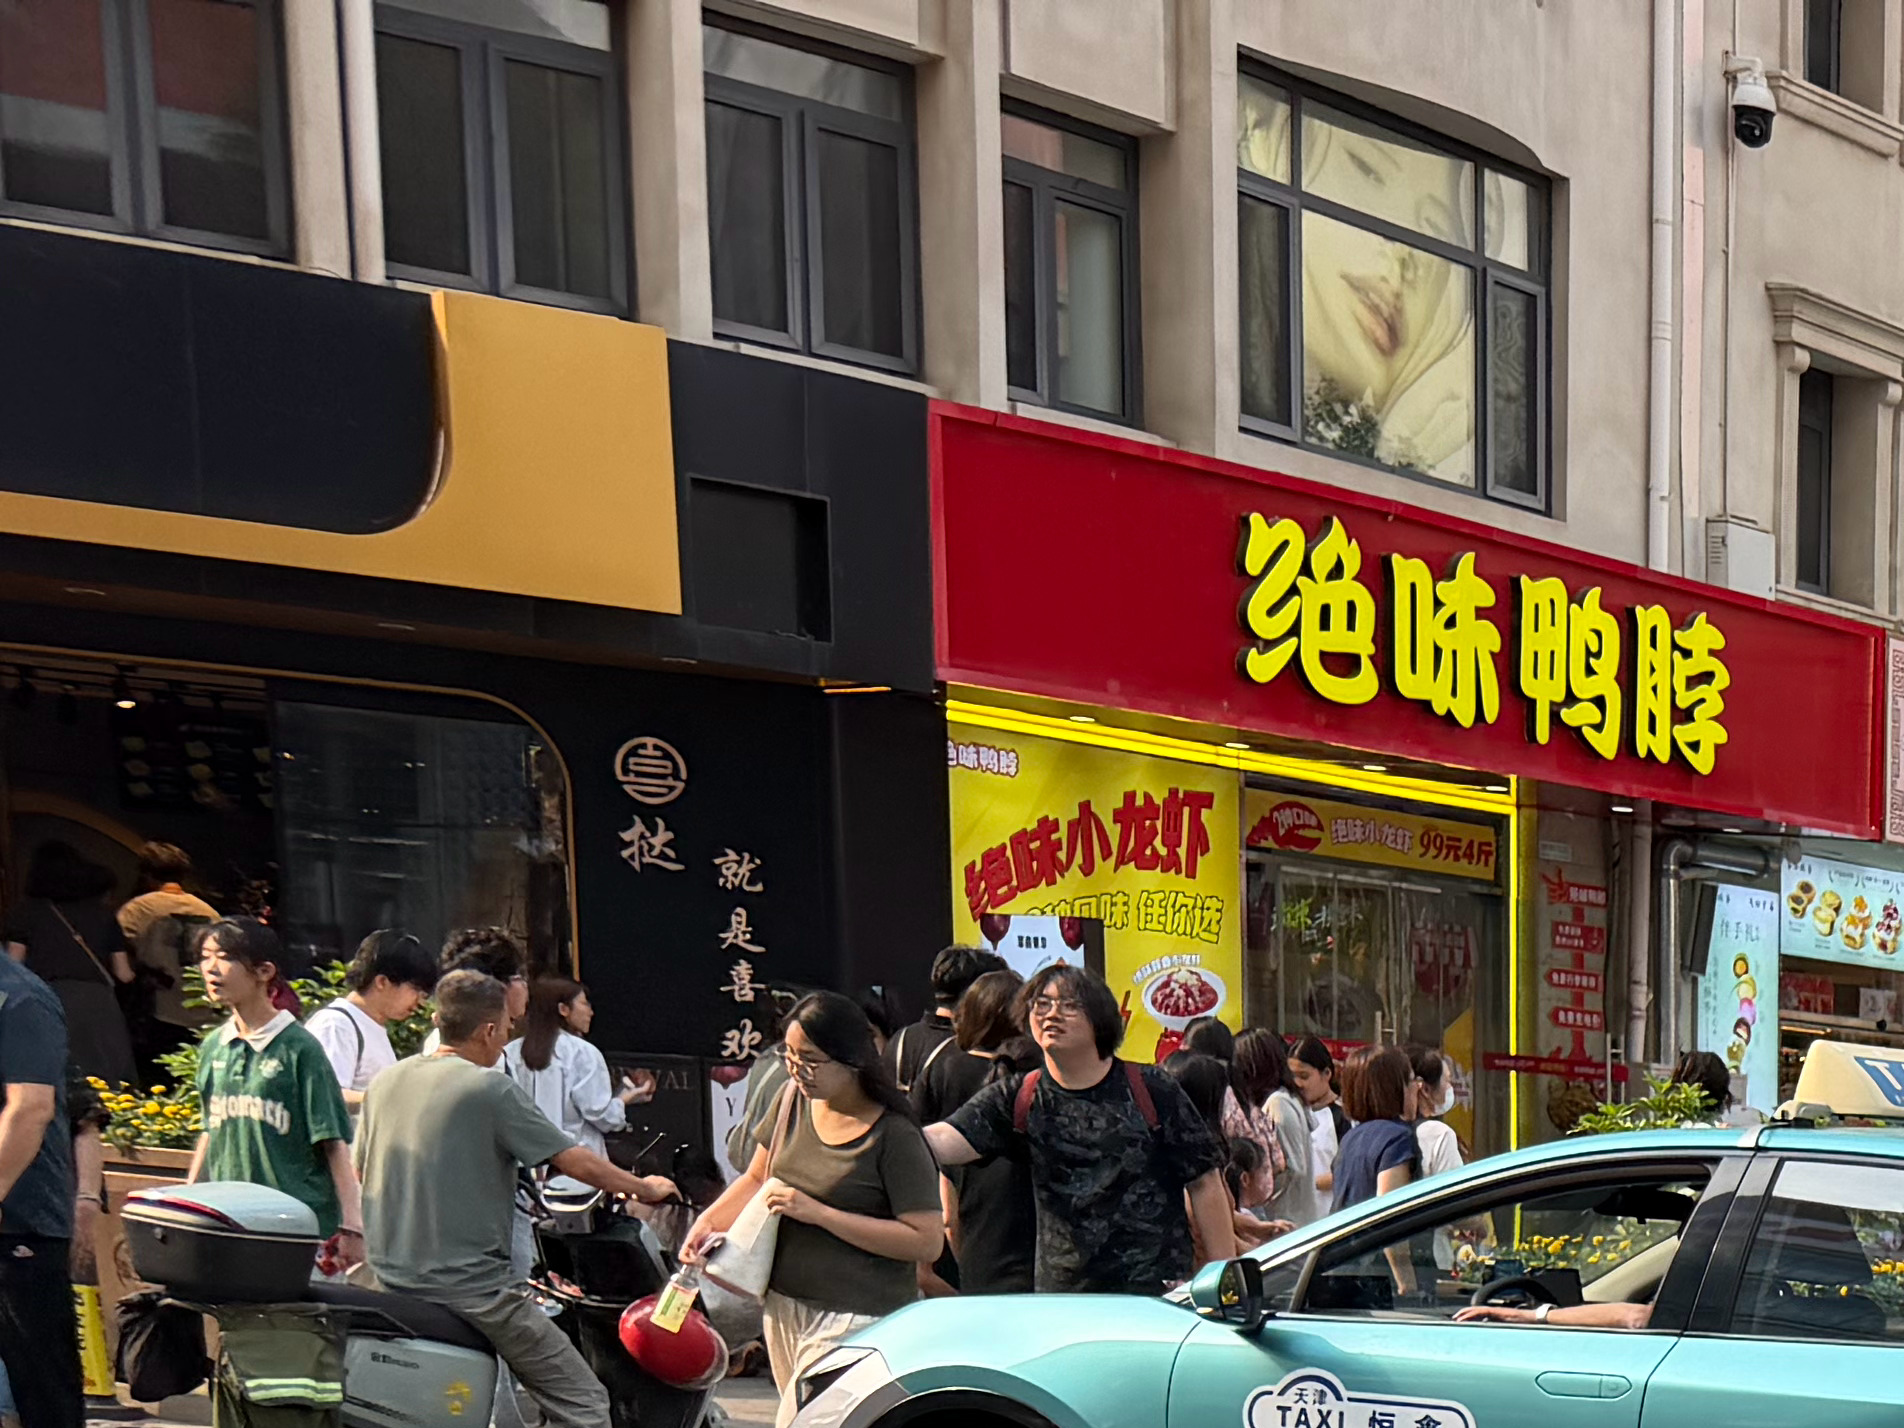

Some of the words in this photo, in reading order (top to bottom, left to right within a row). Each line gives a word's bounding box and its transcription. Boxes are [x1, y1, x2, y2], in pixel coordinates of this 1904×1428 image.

[1242, 511, 1731, 776] 绝味鸭脖
[618, 815, 685, 873] 挞
[964, 787, 1215, 922] 绝味小龙虾
[1331, 818, 1414, 855] 绝味小龙虾
[1419, 830, 1495, 867] 99元4斤
[1136, 889, 1225, 945] 任你选
[713, 848, 767, 1061] 就是喜欢
[1293, 1387, 1329, 1406] 天津
